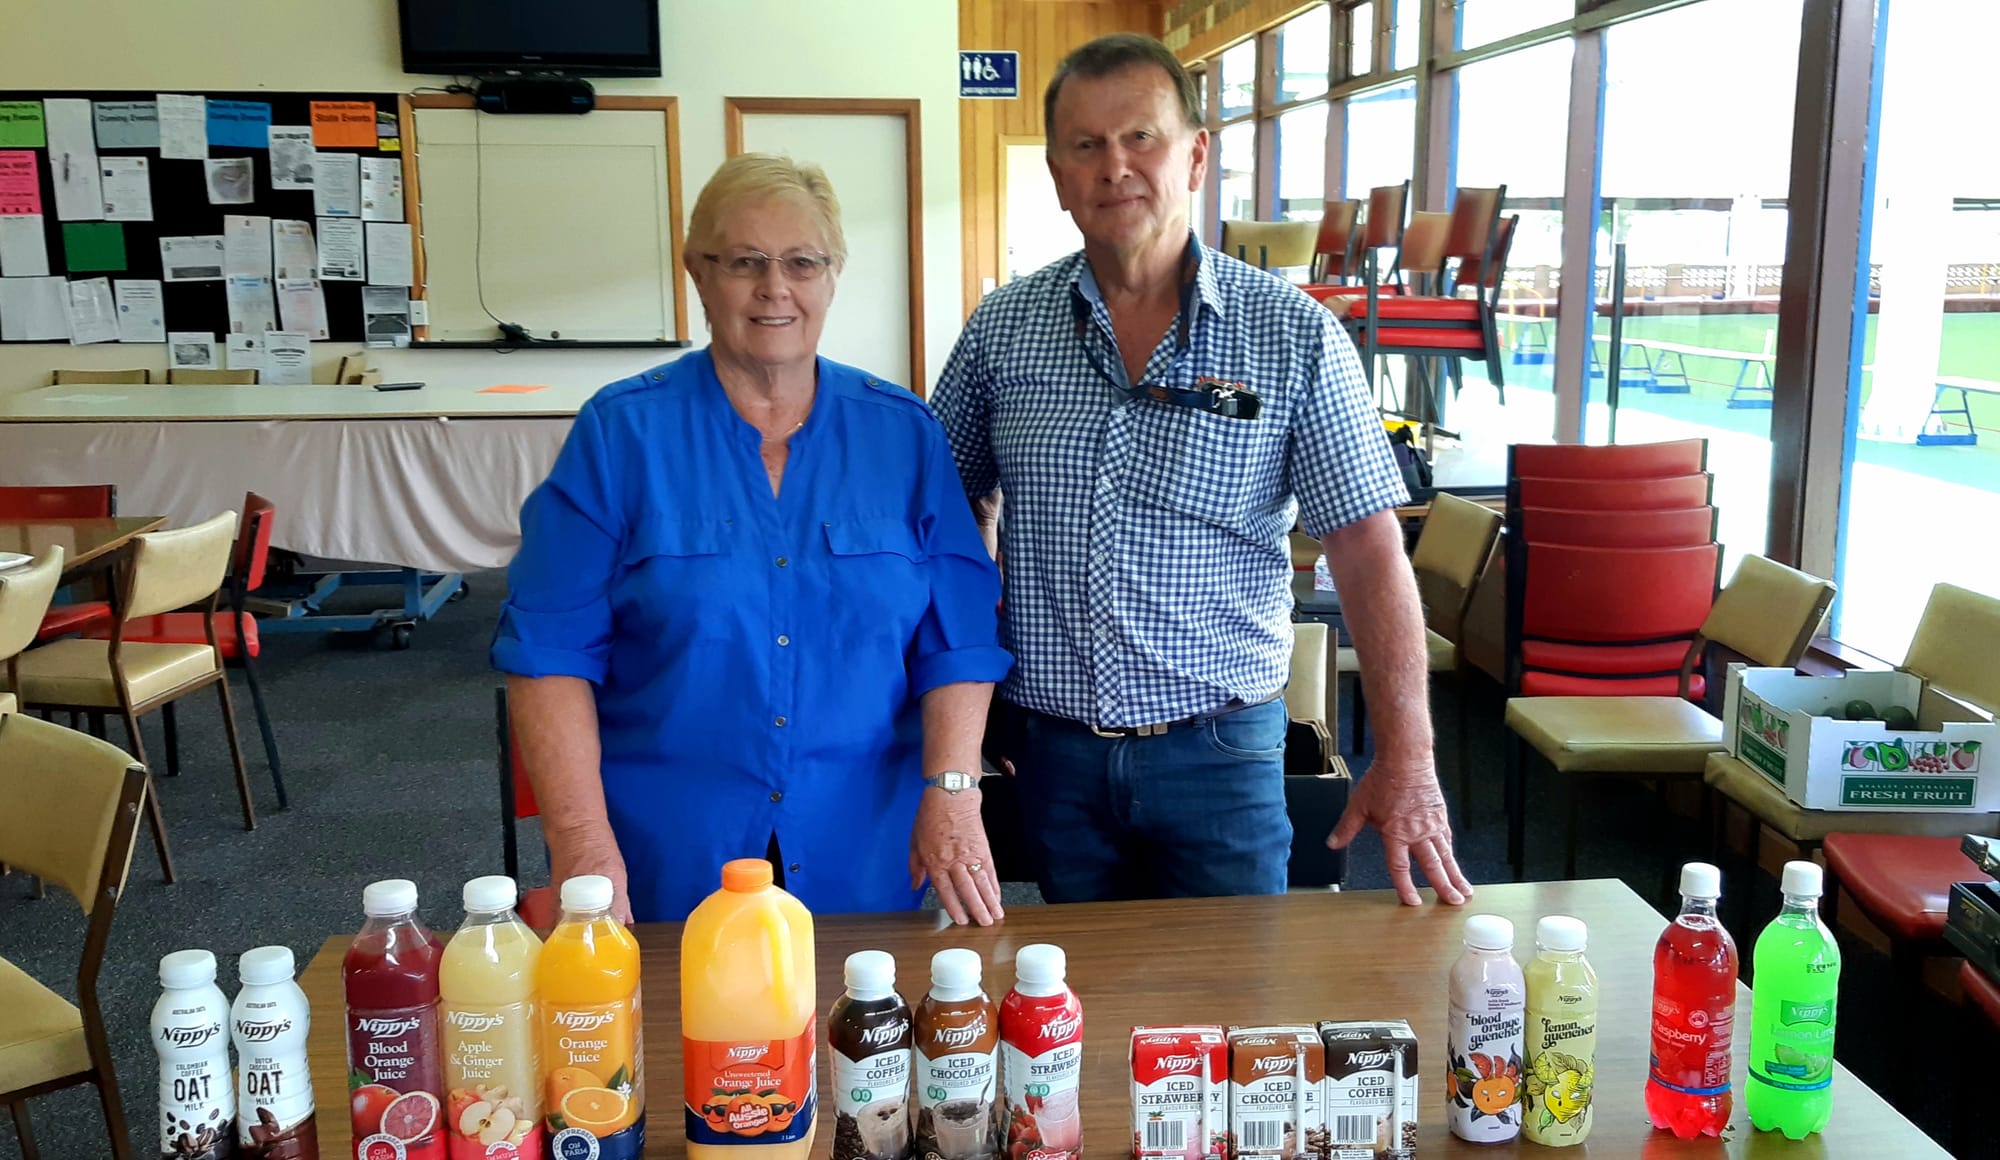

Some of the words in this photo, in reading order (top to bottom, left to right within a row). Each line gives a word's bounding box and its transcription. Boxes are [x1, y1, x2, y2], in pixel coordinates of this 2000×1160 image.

[1850, 790, 1906, 799] FRESH
[1913, 791, 1967, 800] FRUIT
[446, 1010, 505, 1033] Nippy's
[552, 1010, 615, 1032] Nippy's
[1466, 1012, 1501, 1026] blood
[1481, 1017, 1520, 1033] orange
[1541, 1017, 1577, 1033] lemon
[234, 1019, 292, 1042] Nippy's
[355, 1017, 420, 1038] Nippy's
[860, 1018, 909, 1049] Nippy's
[160, 1022, 221, 1049] Nippy's
[933, 1022, 987, 1049] Nippy's
[1468, 1026, 1521, 1051] quencher
[368, 1041, 408, 1055] Blood
[458, 1041, 492, 1055] Apple
[559, 1037, 608, 1050] Orange
[568, 1051, 600, 1065] Juice
[727, 1045, 768, 1063] Nippy's
[874, 1054, 901, 1067] ICED
[1053, 1048, 1075, 1062] ICED
[176, 1061, 208, 1070] COLOMBIAN
[364, 1055, 415, 1069] Orange
[450, 1055, 461, 1066] &
[463, 1055, 503, 1069] Ginger
[948, 1057, 974, 1068] ICED
[181, 1069, 203, 1077] COFFEE
[373, 1069, 406, 1083] Juice
[462, 1067, 491, 1080] Juice
[724, 1070, 770, 1078] Unsweetened
[866, 1062, 906, 1079] COFFEE
[930, 1062, 991, 1079] CHOCOLATE
[174, 1074, 211, 1102] OAT
[247, 1070, 283, 1096] OAT
[714, 1077, 753, 1088] Orange
[756, 1077, 782, 1089] Juice
[1167, 1081, 1194, 1091] ICED
[1264, 1082, 1291, 1092] ICED
[1357, 1077, 1385, 1087] ICED
[1141, 1092, 1221, 1105] STRAWBERY
[1242, 1092, 1314, 1105] CHOCOLAE
[1348, 1087, 1394, 1098] COFFEE
[184, 1102, 205, 1112] MILK
[256, 1097, 275, 1105] MILK
[728, 1107, 768, 1122] Aussie
[741, 1104, 752, 1113] All
[733, 1116, 768, 1129] Oranges
